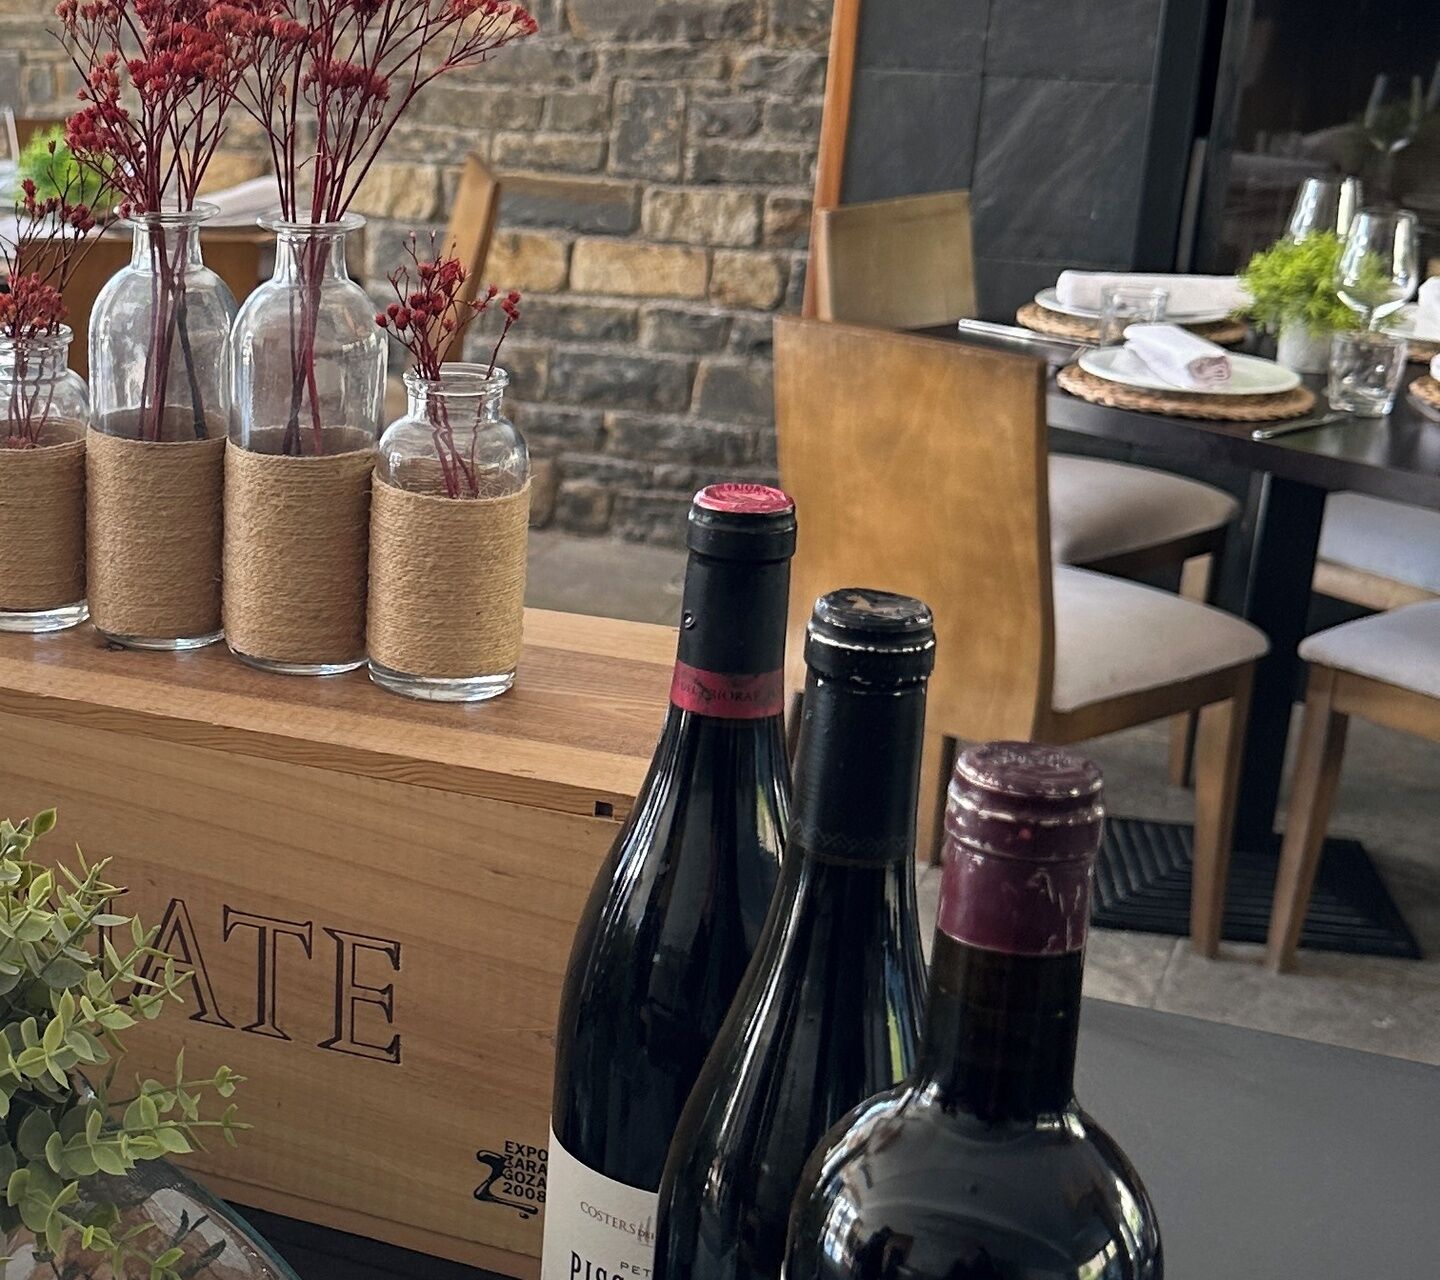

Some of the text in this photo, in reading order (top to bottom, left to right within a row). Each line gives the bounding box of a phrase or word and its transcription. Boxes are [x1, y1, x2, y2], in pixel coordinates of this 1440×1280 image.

[98, 897, 402, 1065] ATE
[505, 1140, 549, 1162] EXPO
[504, 1154, 548, 1177] ZARA
[502, 1168, 547, 1190] GOZA
[502, 1181, 546, 1203] 2008
[580, 1201, 636, 1235] COSTERS
